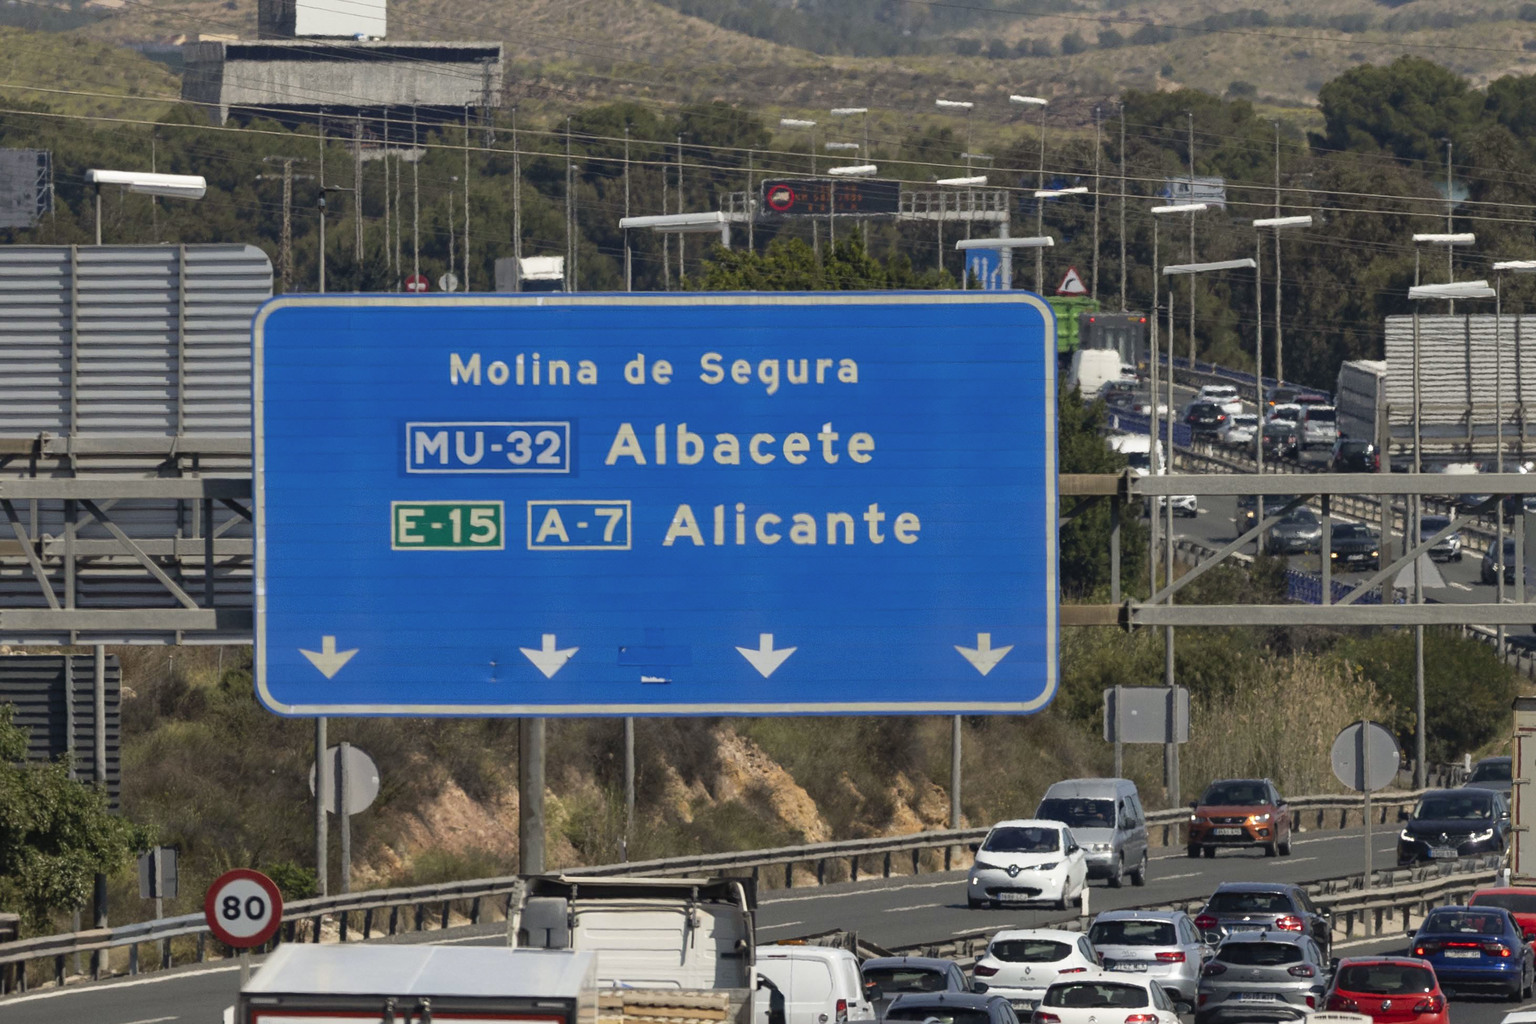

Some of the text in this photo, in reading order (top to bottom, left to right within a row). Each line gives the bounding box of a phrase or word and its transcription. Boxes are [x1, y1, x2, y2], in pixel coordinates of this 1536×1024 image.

[450, 353, 860, 395] Molina de Segura
[414, 423, 876, 466] MU-32 Albacete
[399, 503, 922, 547] E-15 A-7 Alicante
[222, 896, 266, 921] 80
